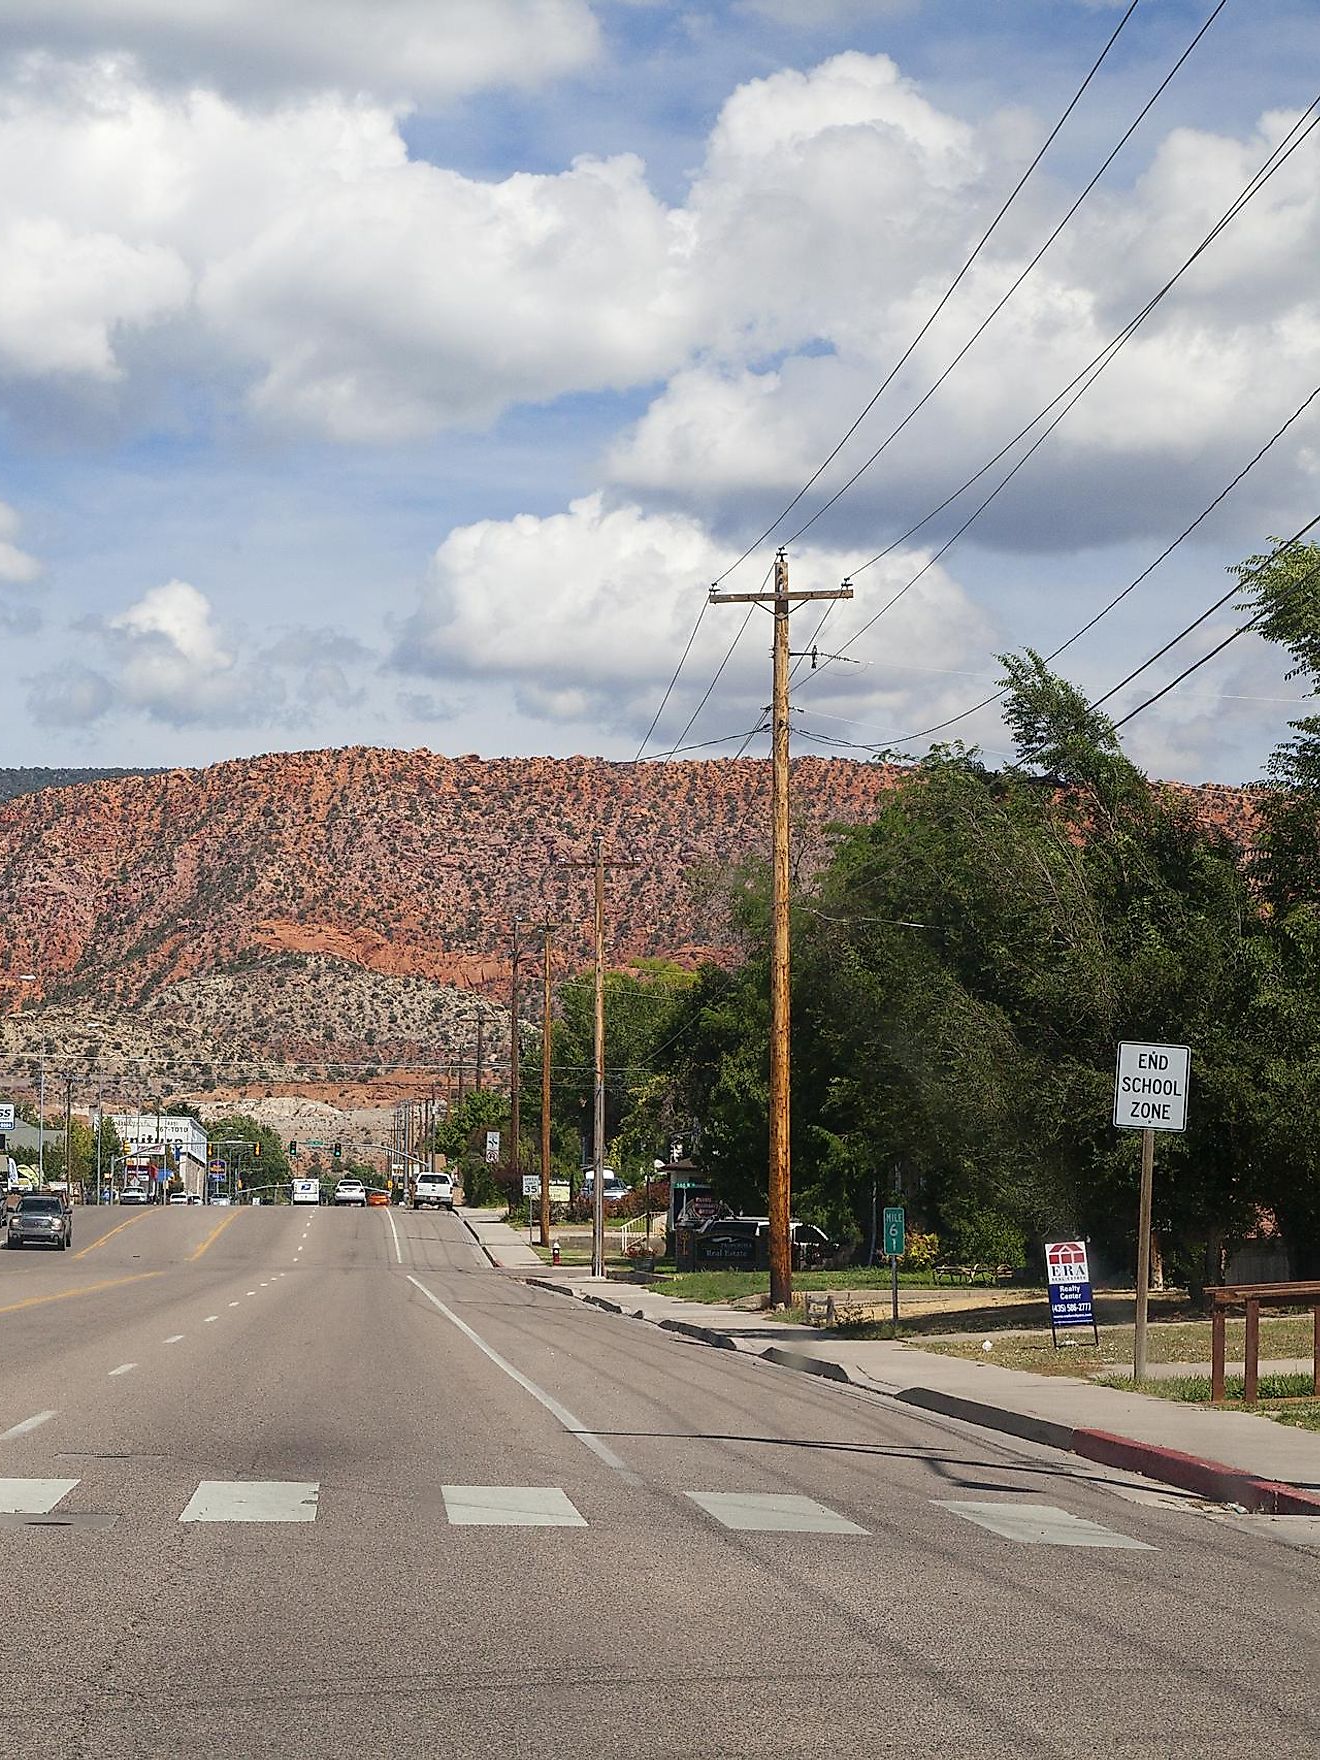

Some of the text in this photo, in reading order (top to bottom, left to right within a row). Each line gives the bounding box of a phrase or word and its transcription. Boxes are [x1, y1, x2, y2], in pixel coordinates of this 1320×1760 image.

[1139, 1053, 1169, 1071] END
[1122, 1077, 1182, 1097] SCHOOL
[1130, 1101, 1171, 1120] ZONE
[524, 1185, 538, 1193] 35
[886, 1213, 903, 1223] MILE
[889, 1223, 898, 1237] 6
[892, 1238, 897, 1250] 1
[724, 1249, 748, 1257] Estate
[1051, 1264, 1085, 1277] ERA
[1059, 1284, 1080, 1293] Realty
[1060, 1292, 1082, 1300] Center
